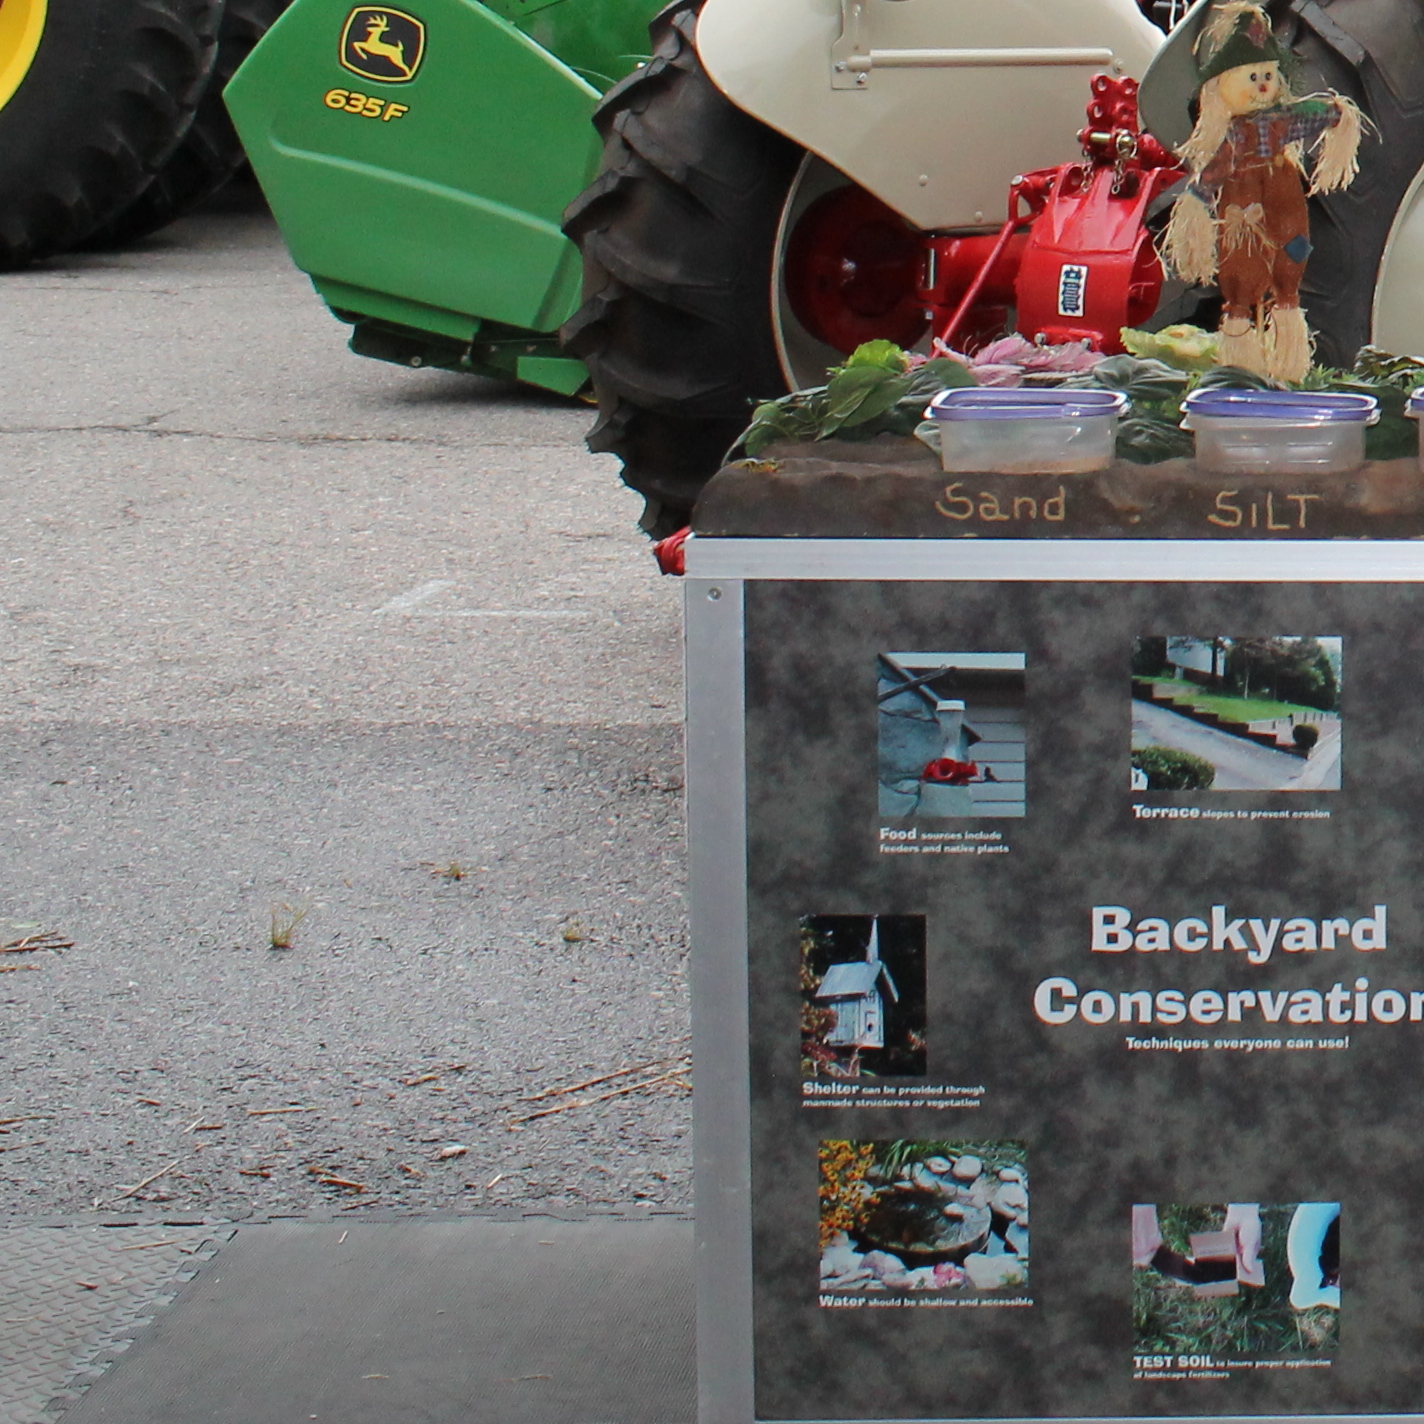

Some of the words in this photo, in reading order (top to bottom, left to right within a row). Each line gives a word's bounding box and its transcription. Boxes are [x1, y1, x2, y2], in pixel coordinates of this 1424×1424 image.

[324, 88, 409, 123] 635F
[936, 484, 1066, 522] Sand
[1132, 804, 1201, 819] Terrace
[879, 827, 917, 841] Food
[1091, 904, 1387, 964] Backyard
[1125, 1036, 1210, 1053] Techniques
[1213, 1038, 1282, 1052] everyone
[1286, 1038, 1314, 1049] can
[1318, 1035, 1350, 1049] use!
[802, 1081, 860, 1095] Shelter
[818, 1294, 866, 1308] Water
[1133, 1355, 1174, 1369] TEST
[1177, 1354, 1215, 1368] SOIL
